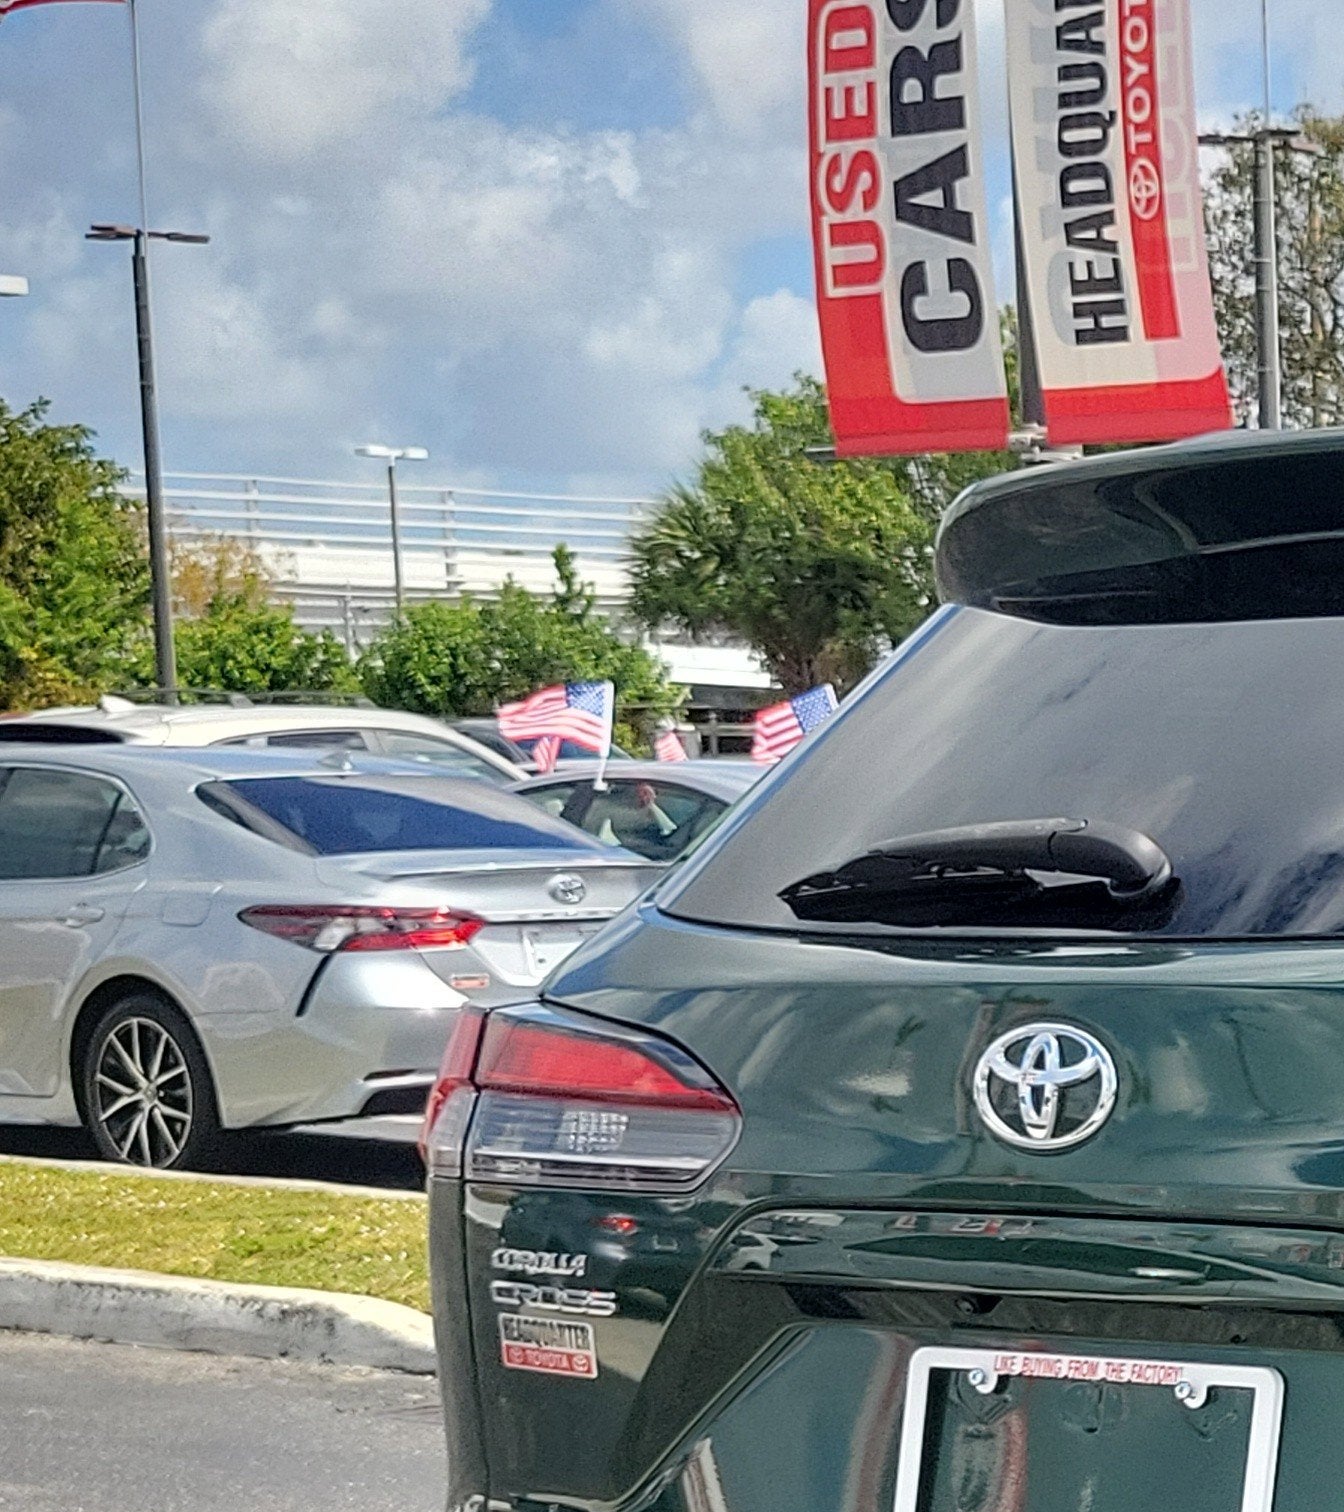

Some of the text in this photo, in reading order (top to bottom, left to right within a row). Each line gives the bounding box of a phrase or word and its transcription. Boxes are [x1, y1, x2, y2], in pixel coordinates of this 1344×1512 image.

[820, 2, 886, 294] USED
[1055, 0, 1131, 345] HEADQUA
[491, 1247, 588, 1277] COROLLA
[489, 1279, 617, 1317] CROSS
[525, 1350, 570, 1369] TOYOTA
[993, 1355, 1017, 1373] LIKE
[1022, 1356, 1062, 1377] BUYING
[1068, 1359, 1099, 1378] FROM
[1104, 1361, 1127, 1380] THE
